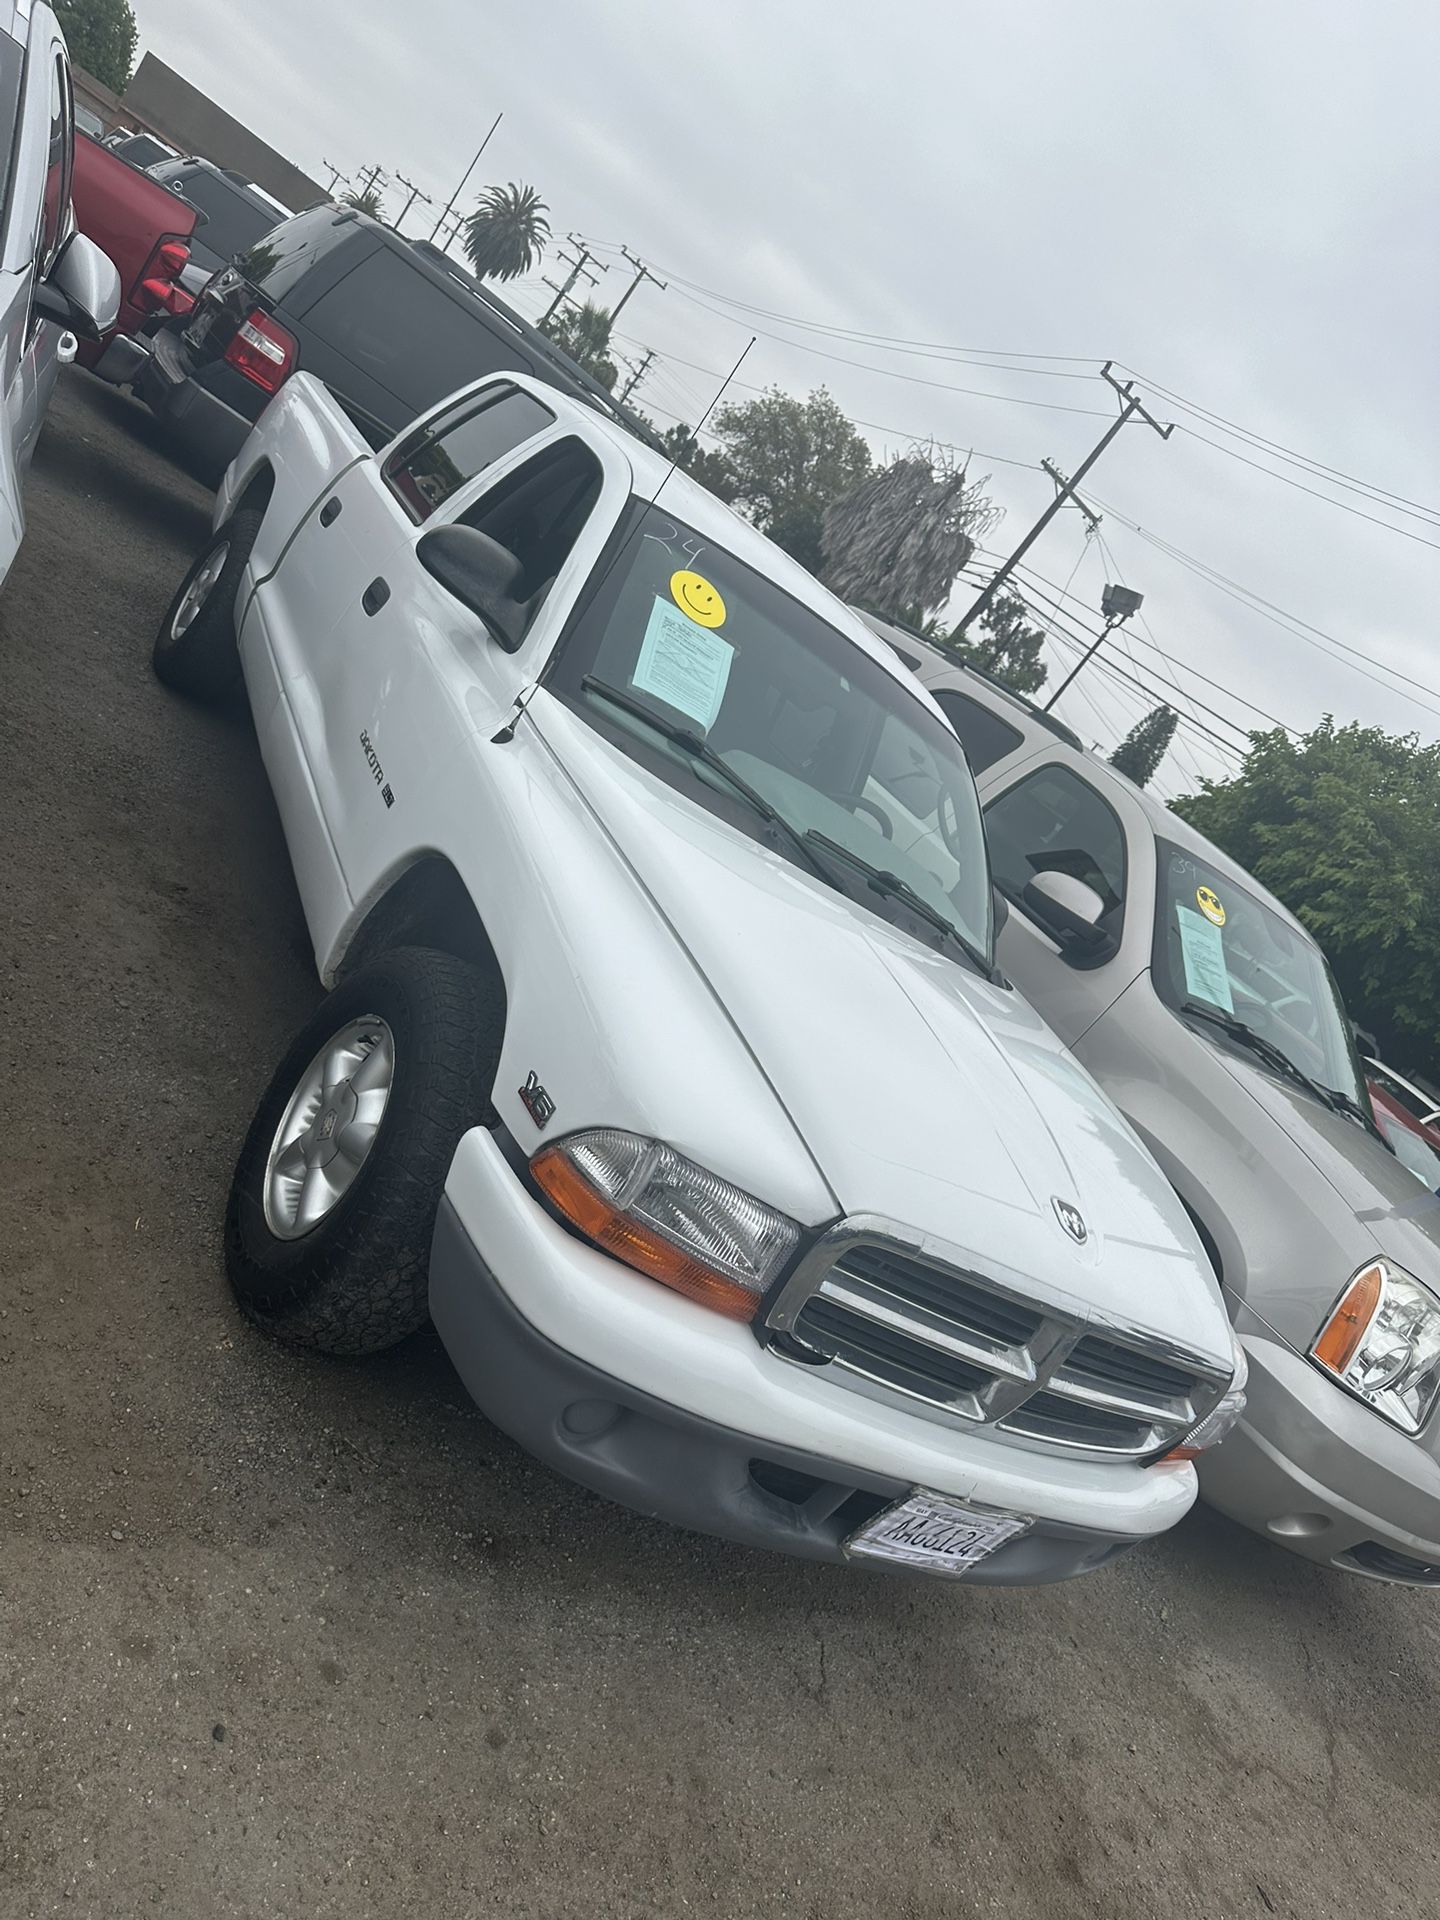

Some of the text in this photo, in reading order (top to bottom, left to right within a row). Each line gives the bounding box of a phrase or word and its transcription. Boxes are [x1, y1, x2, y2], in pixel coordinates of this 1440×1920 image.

[643, 522, 706, 570] 24
[359, 728, 384, 785] DAKOTA
[1171, 851, 1196, 880] 39
